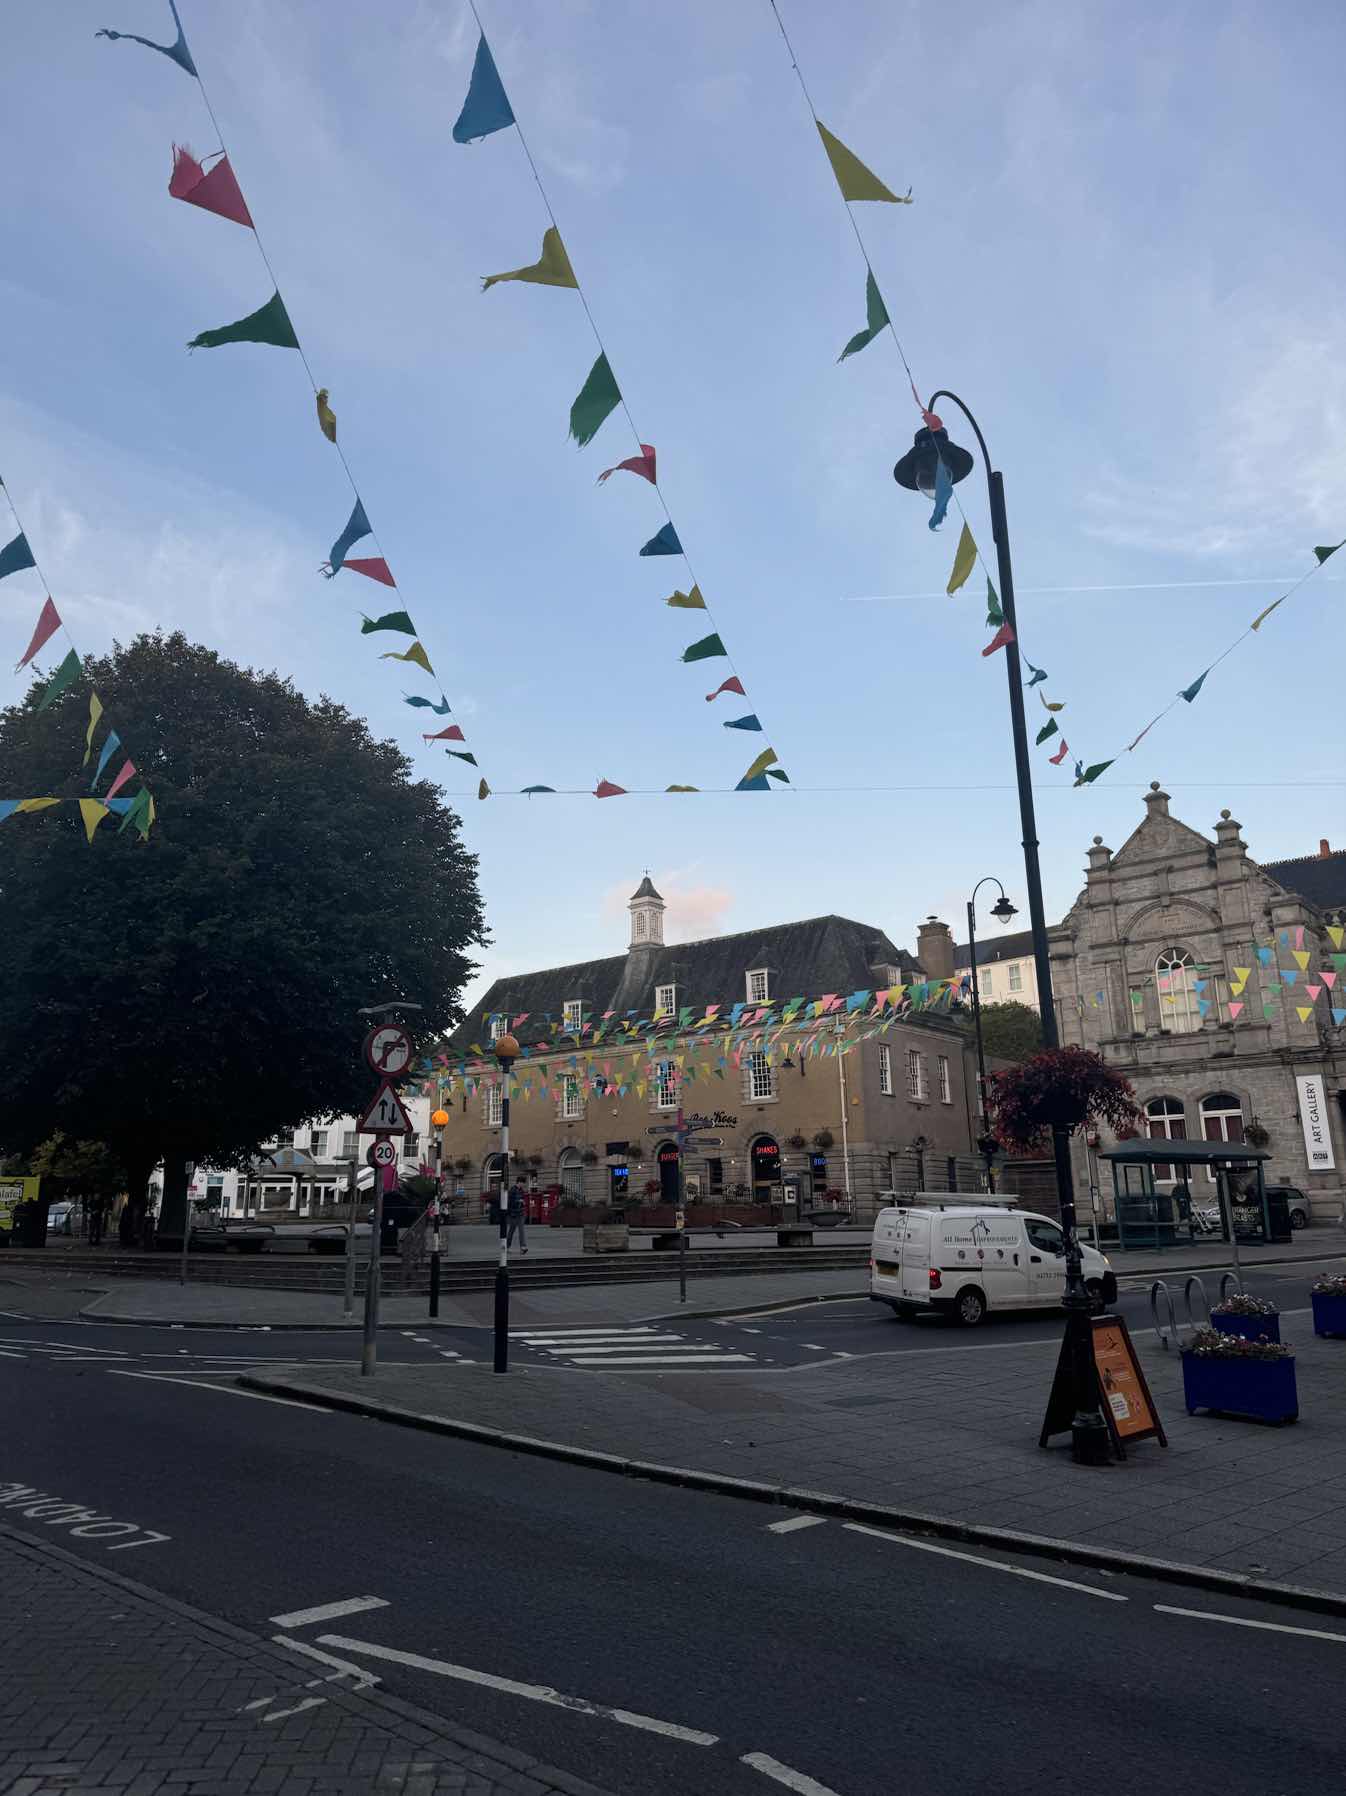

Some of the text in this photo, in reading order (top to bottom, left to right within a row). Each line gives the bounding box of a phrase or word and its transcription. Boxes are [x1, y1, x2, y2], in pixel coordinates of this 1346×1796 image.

[1305, 1081, 1320, 1123] GALLERY
[1312, 1125, 1323, 1143] ART
[377, 1147, 392, 1159] 20
